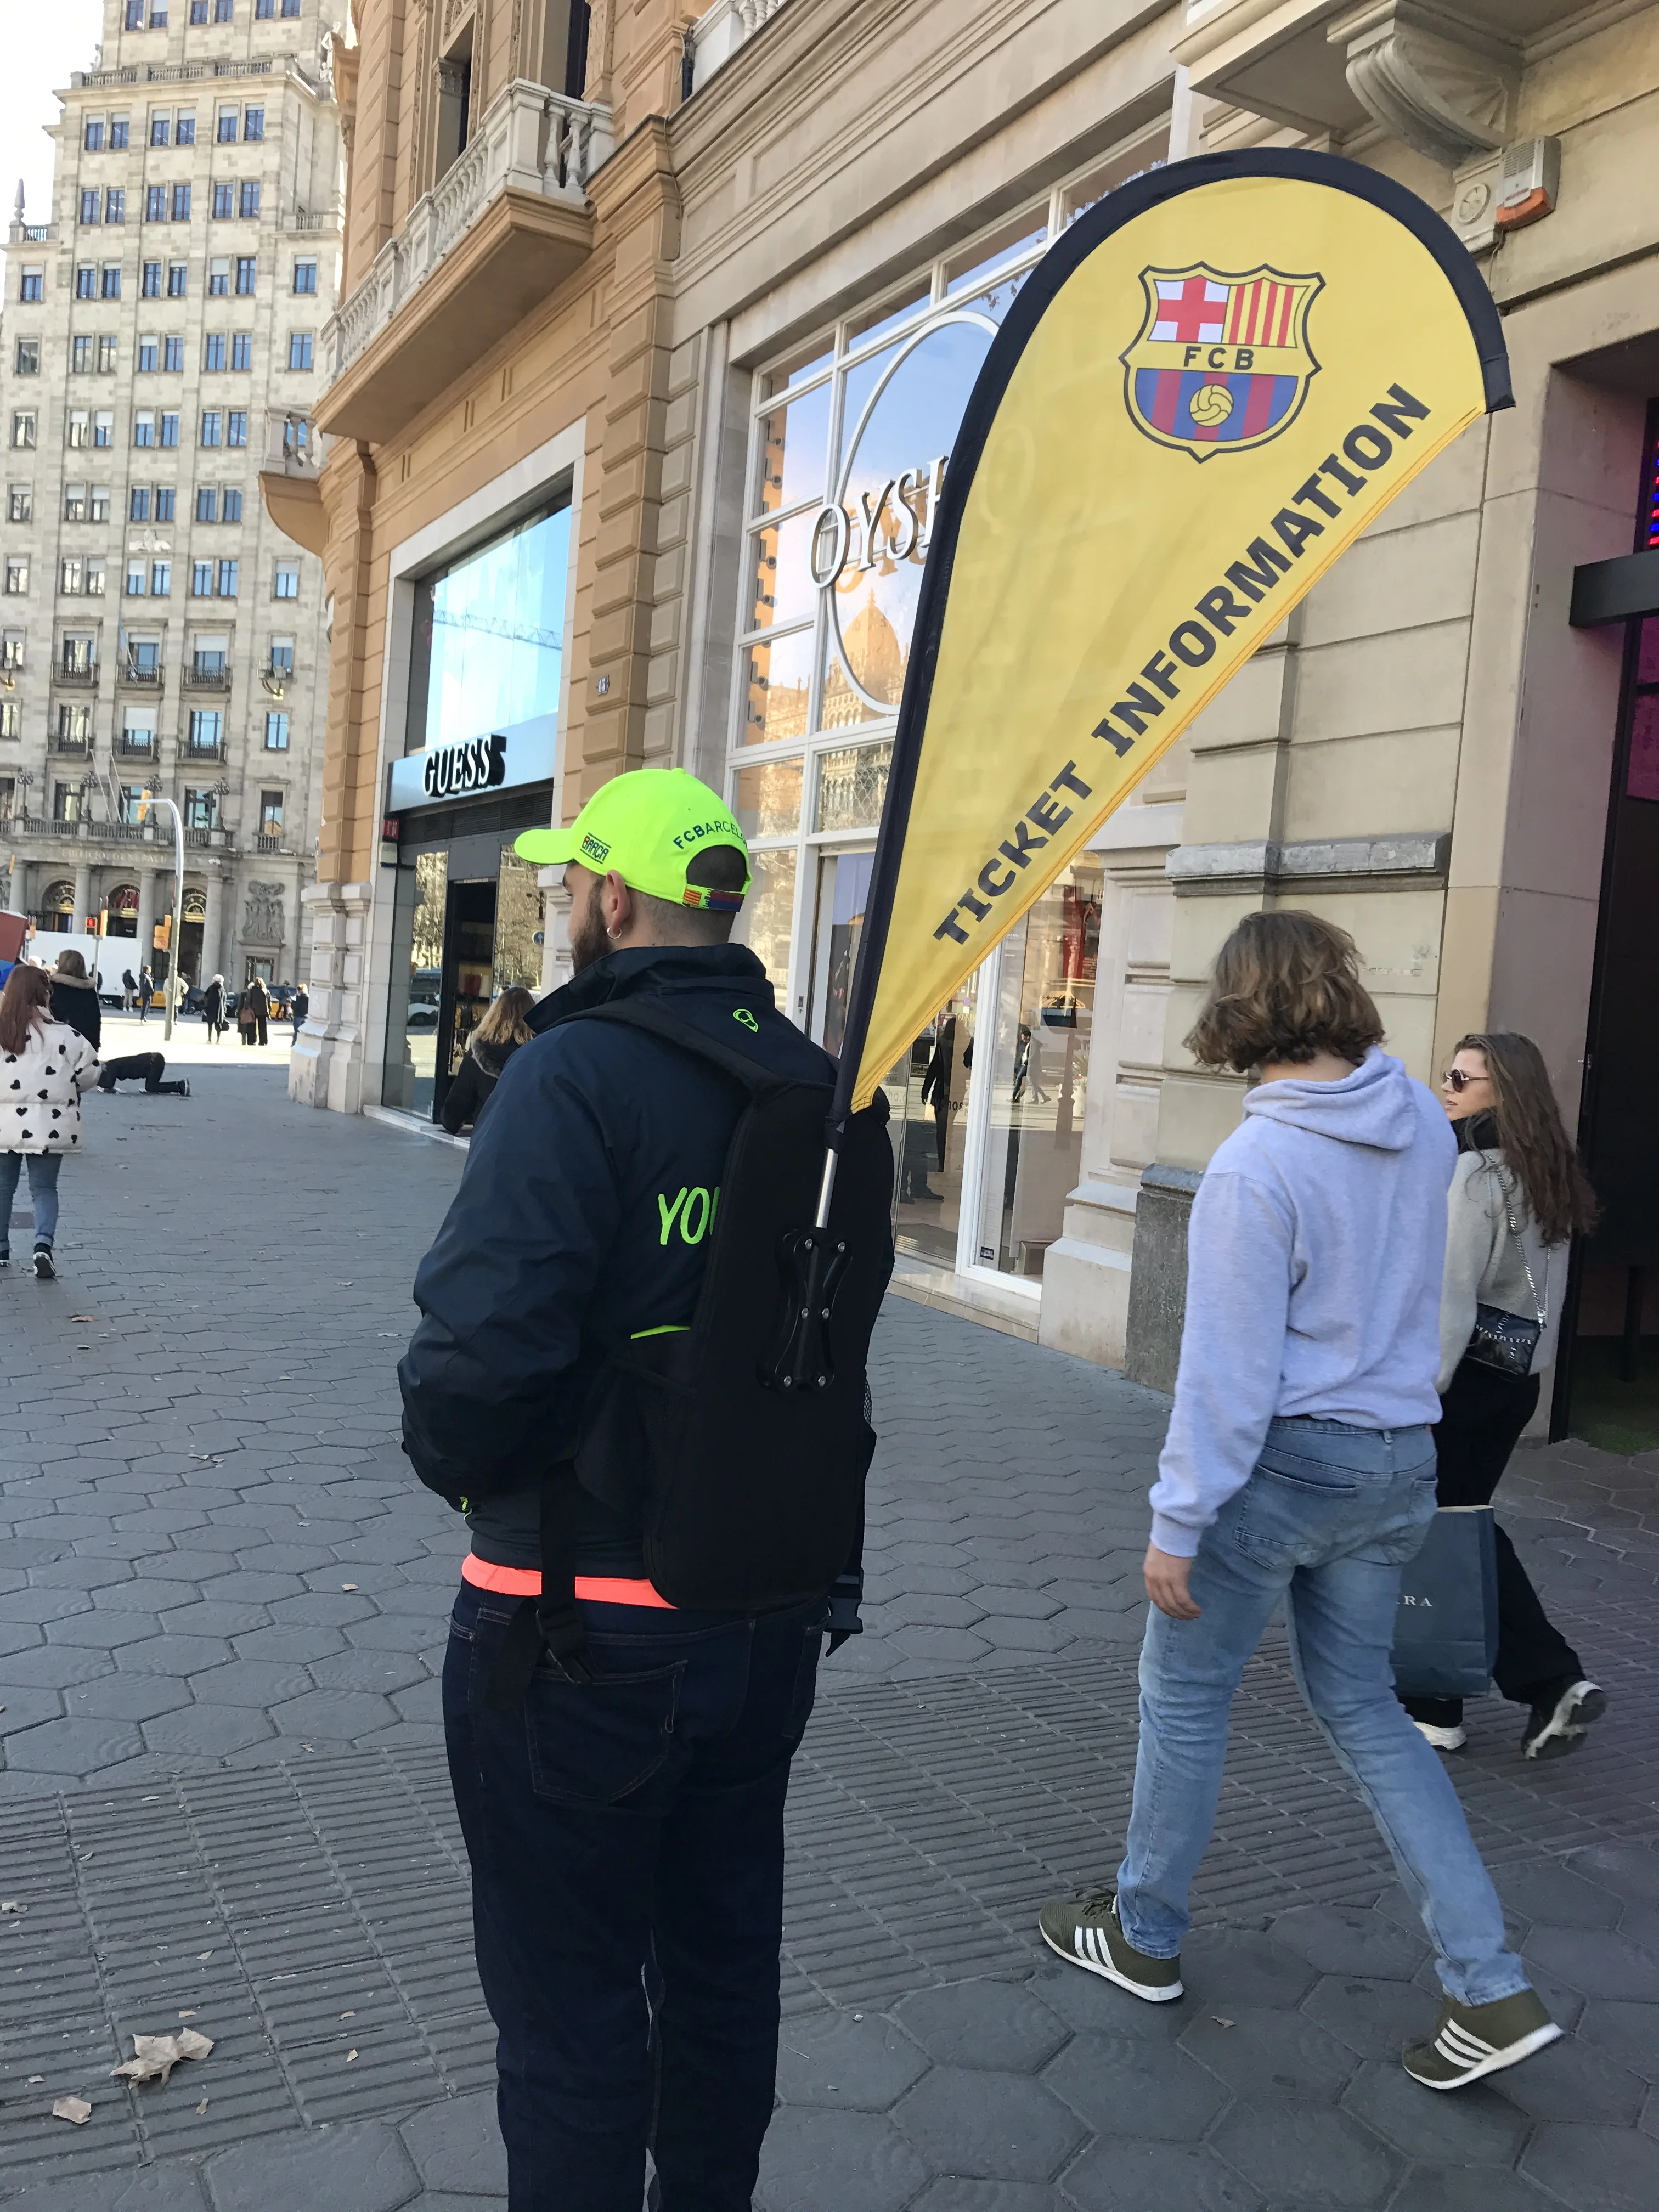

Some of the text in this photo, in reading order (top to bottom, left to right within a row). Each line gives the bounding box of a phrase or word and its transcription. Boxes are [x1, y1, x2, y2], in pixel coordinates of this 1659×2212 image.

[1183, 346, 1254, 370] FCB
[933, 383, 1431, 945] TICKET INFORMATION
[422, 733, 493, 797] GUESS
[1395, 1595, 1433, 1607] RA
